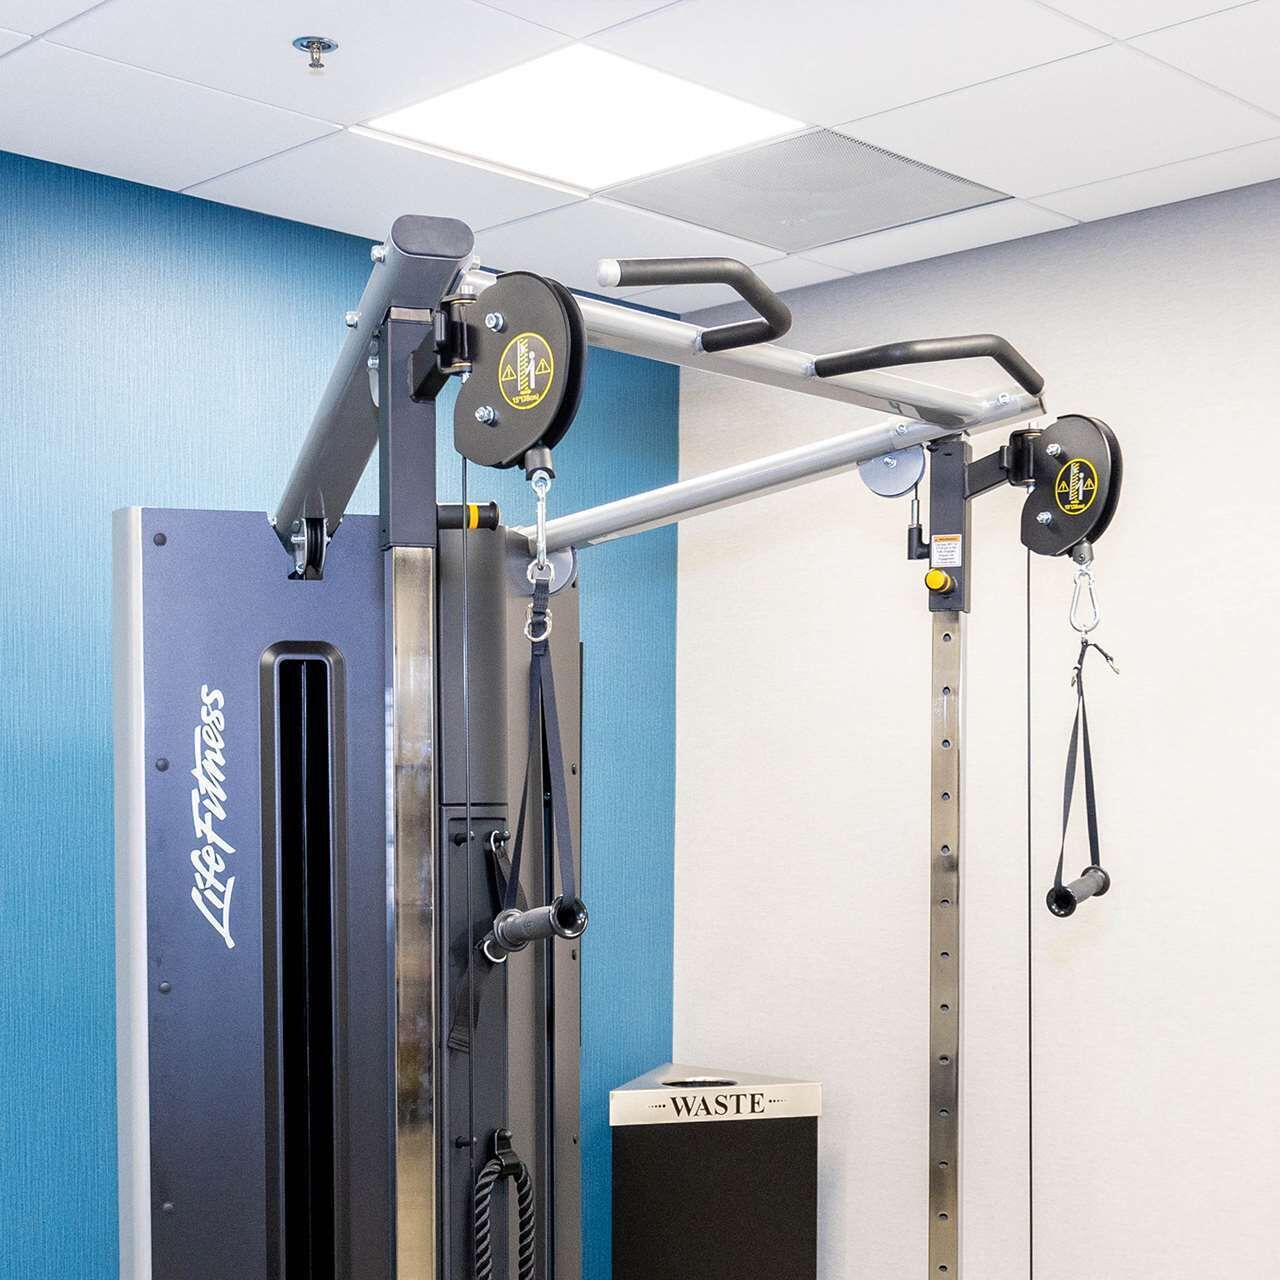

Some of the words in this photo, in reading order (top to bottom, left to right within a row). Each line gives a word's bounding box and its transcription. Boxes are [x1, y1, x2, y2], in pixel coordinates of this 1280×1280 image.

[191, 684, 236, 854] Fitness
[191, 849, 236, 949] Life
[670, 1092, 766, 1117] WASTE
